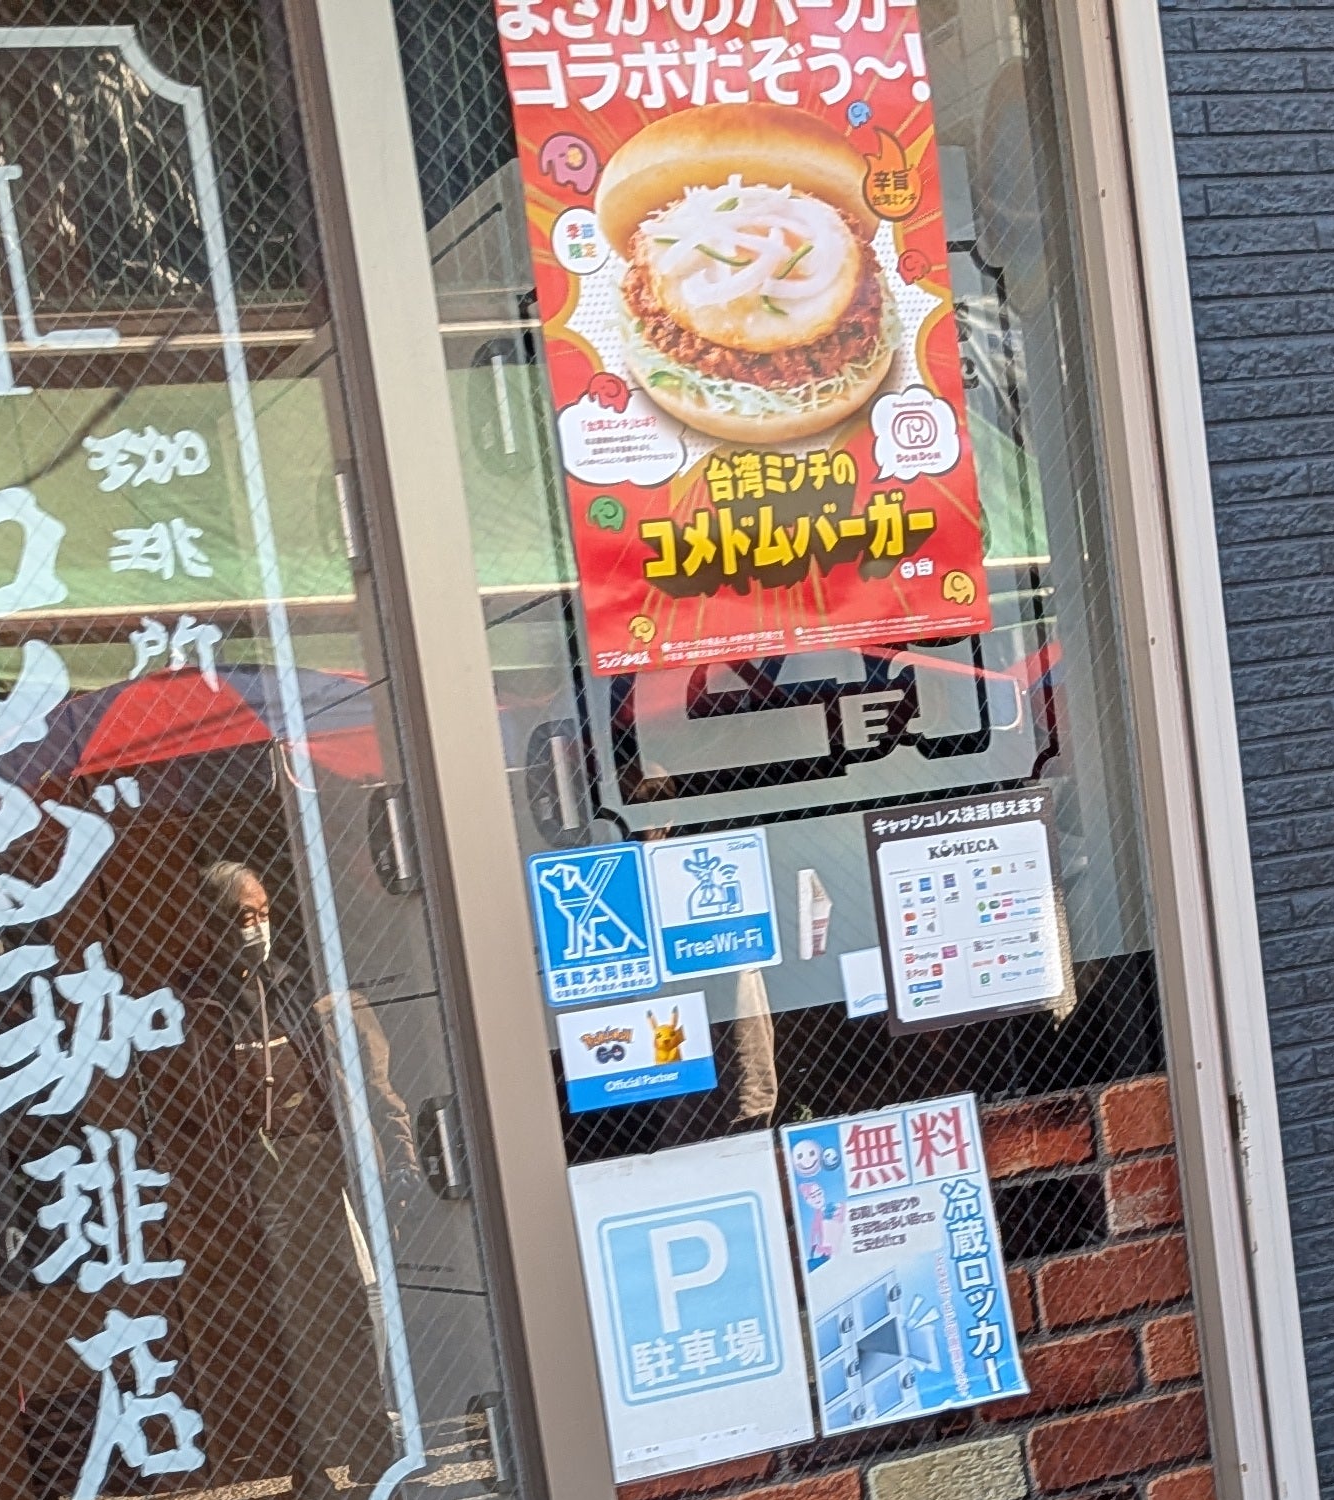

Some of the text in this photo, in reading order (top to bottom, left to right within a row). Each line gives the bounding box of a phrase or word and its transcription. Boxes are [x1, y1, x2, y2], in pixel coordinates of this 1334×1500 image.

[707, 452, 856, 503] 台湾ミンチの
[641, 491, 935, 578] コメドムバーガー
[872, 796, 1045, 835] キャッシュレス決済使えます
[604, 1071, 679, 1092] Official Partner
[844, 1106, 971, 1190] 無料
[647, 1219, 729, 1333] P
[940, 1179, 1005, 1393] 冷蔵ロッカー
[632, 1317, 767, 1388] 駐車場
